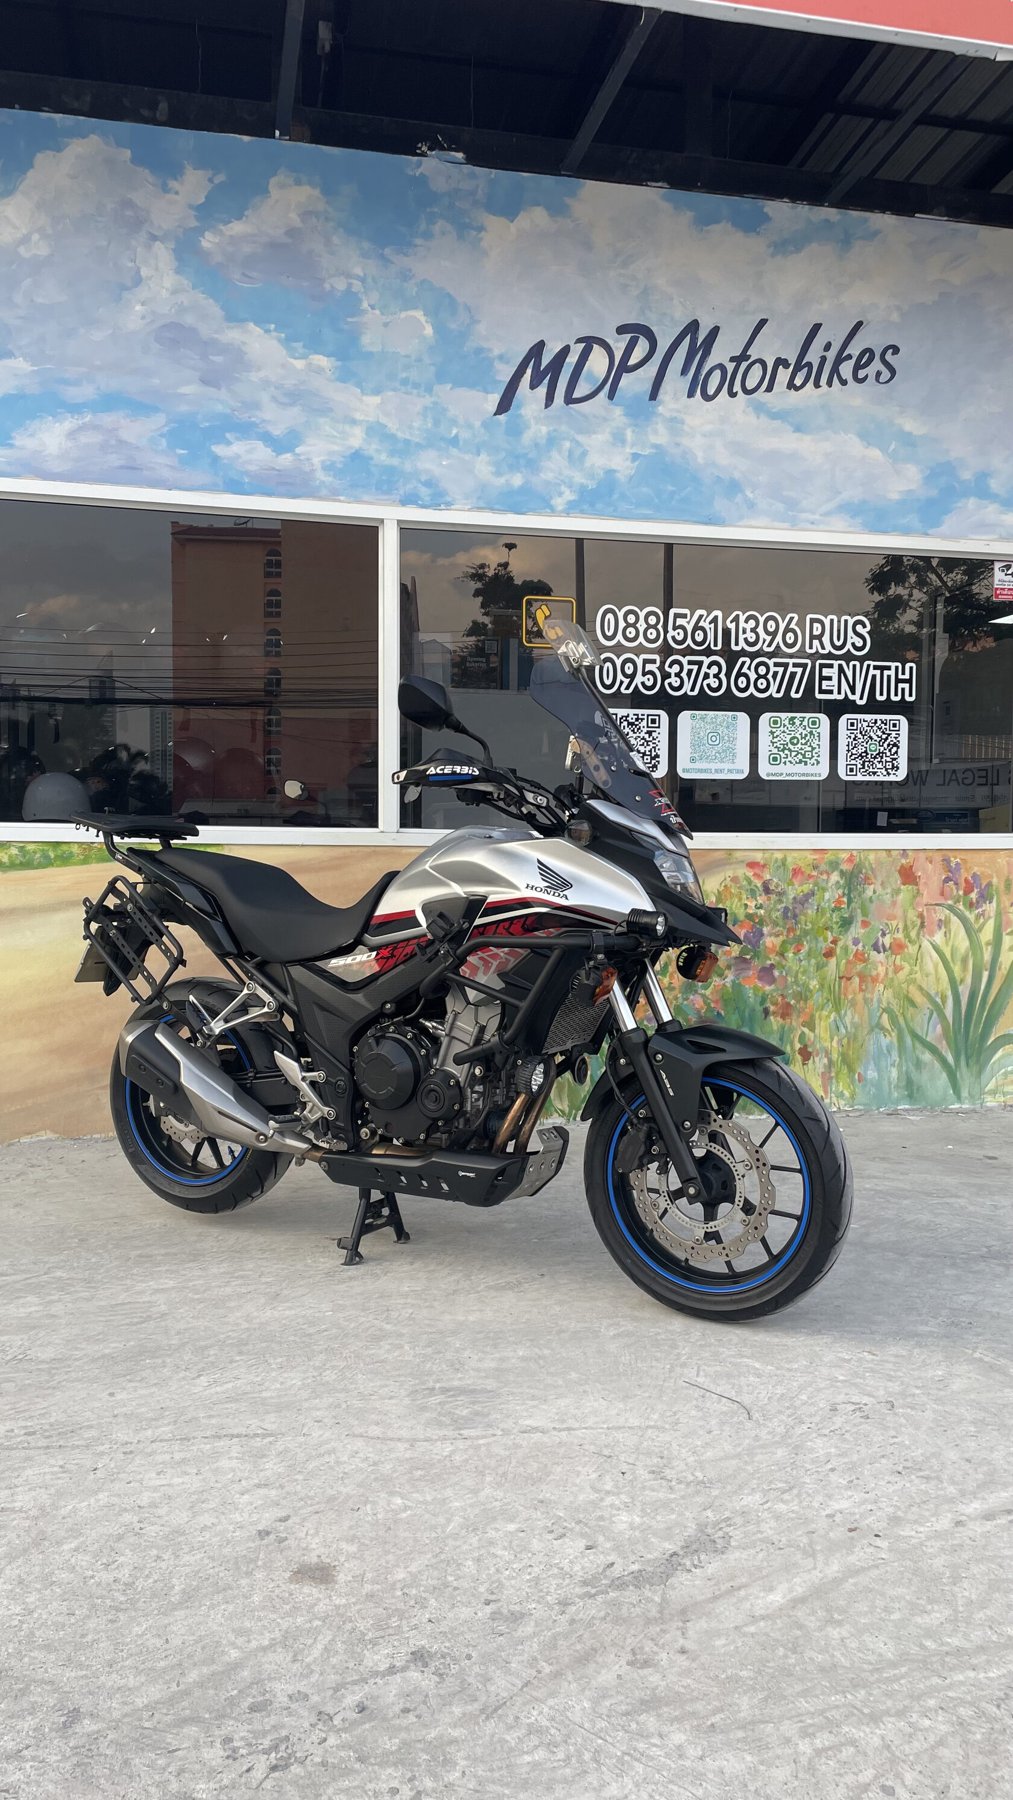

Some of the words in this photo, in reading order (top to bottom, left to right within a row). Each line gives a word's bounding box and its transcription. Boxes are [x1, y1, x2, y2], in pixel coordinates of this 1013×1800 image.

[493, 322, 658, 417] MDP
[648, 318, 901, 402] Motorbikes
[596, 605, 663, 647] 088
[667, 608, 721, 649] 561
[726, 611, 800, 653] 1396
[805, 614, 871, 655] RUS
[596, 653, 661, 695] 095
[664, 655, 727, 697] 373
[730, 657, 811, 698] 6877
[815, 659, 917, 704] EN/TH
[426, 765, 479, 776] ACERBIS
[525, 883, 570, 901] HONDA
